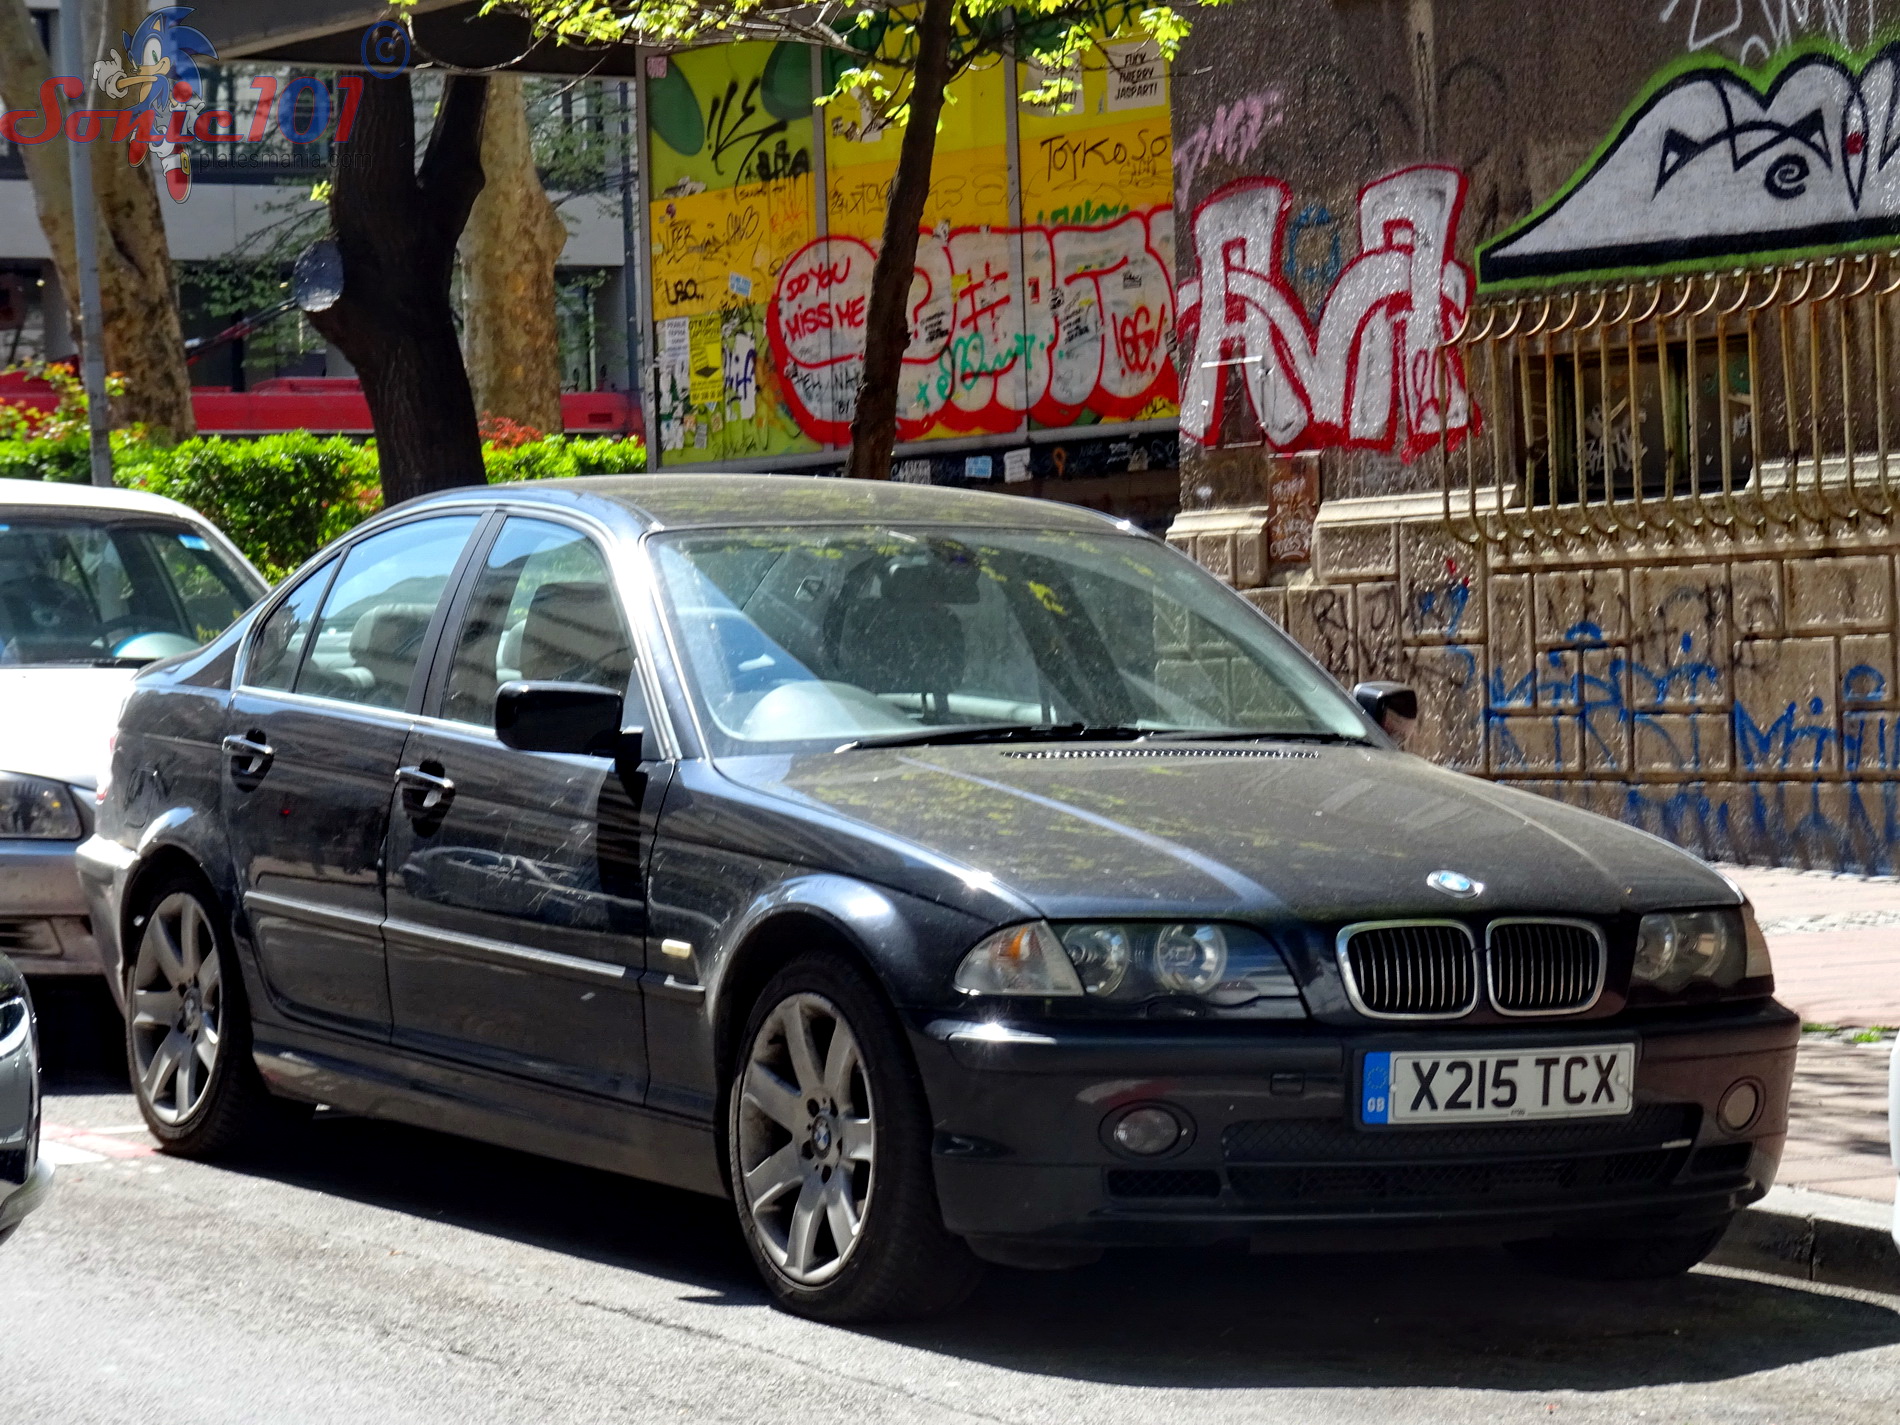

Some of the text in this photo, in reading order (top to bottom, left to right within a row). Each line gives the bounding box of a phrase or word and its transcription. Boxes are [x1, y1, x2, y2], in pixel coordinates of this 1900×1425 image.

[808, 256, 851, 297] YOU
[1410, 1054, 1618, 1112] X215 TCX
[1367, 1097, 1385, 1113] GB
